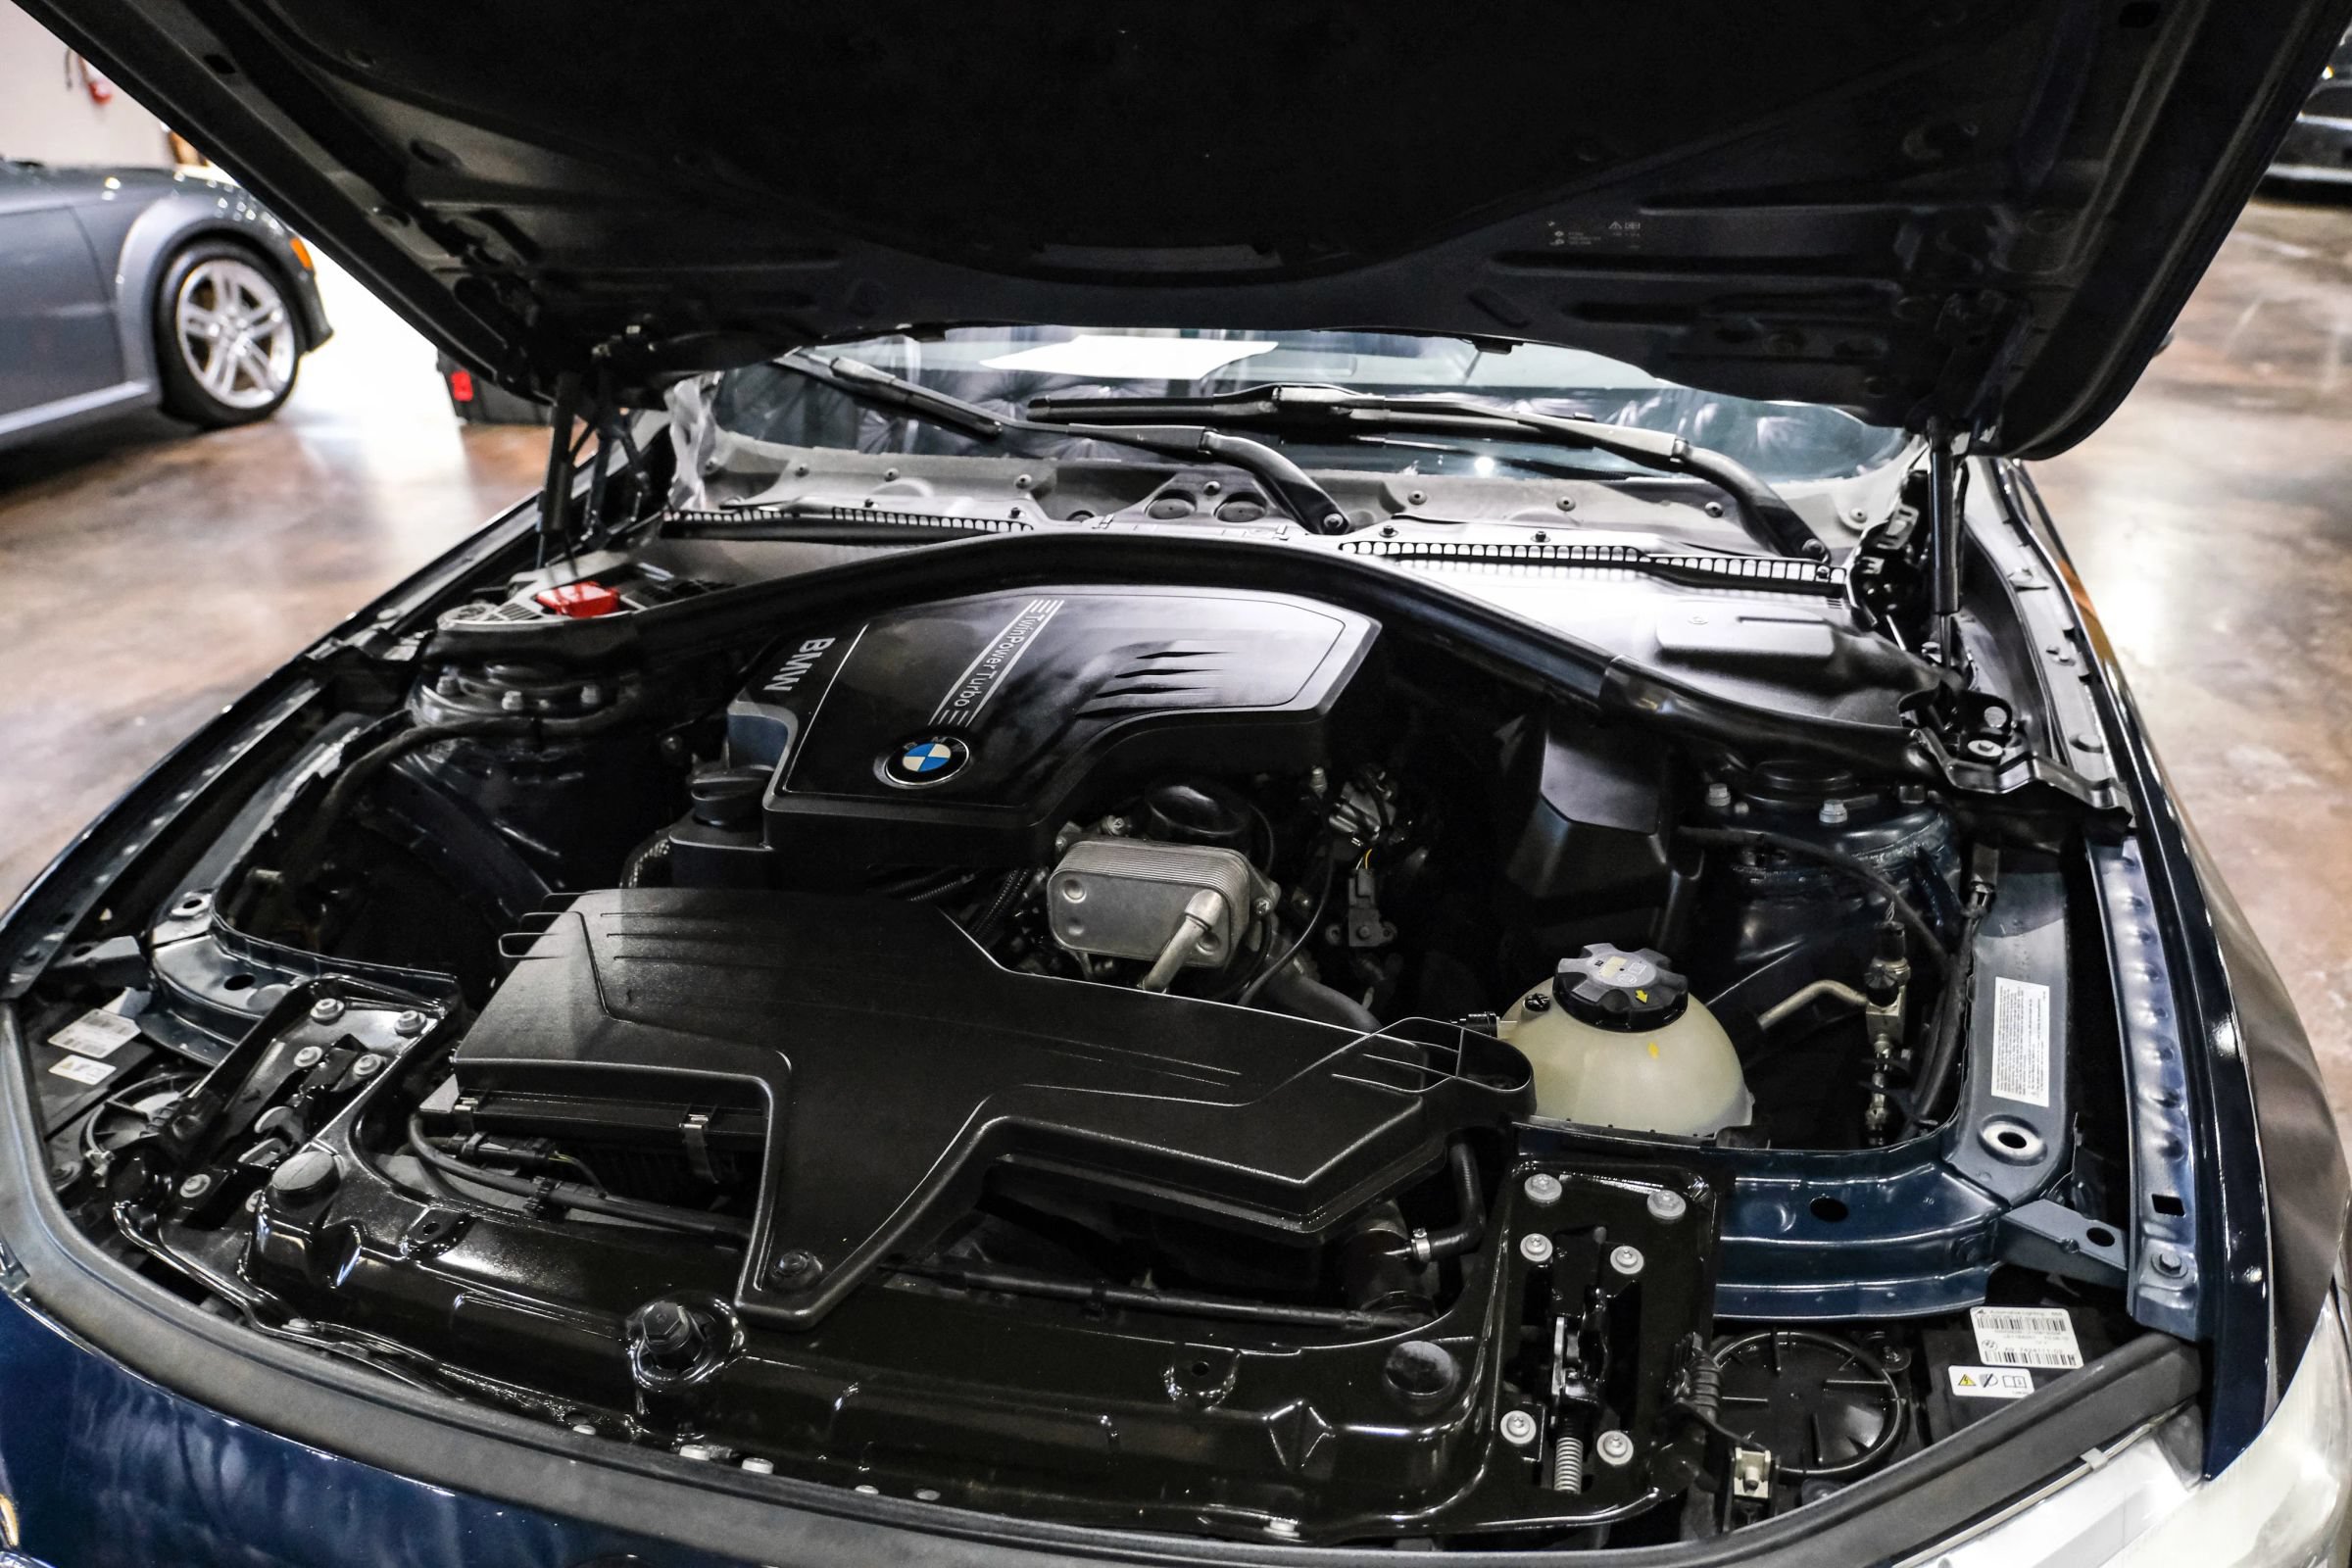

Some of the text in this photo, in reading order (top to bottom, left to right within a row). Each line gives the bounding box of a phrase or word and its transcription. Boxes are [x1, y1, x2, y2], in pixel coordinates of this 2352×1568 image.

[762, 637, 836, 691] BMW
[954, 614, 1045, 707] TwinPower Turbo
